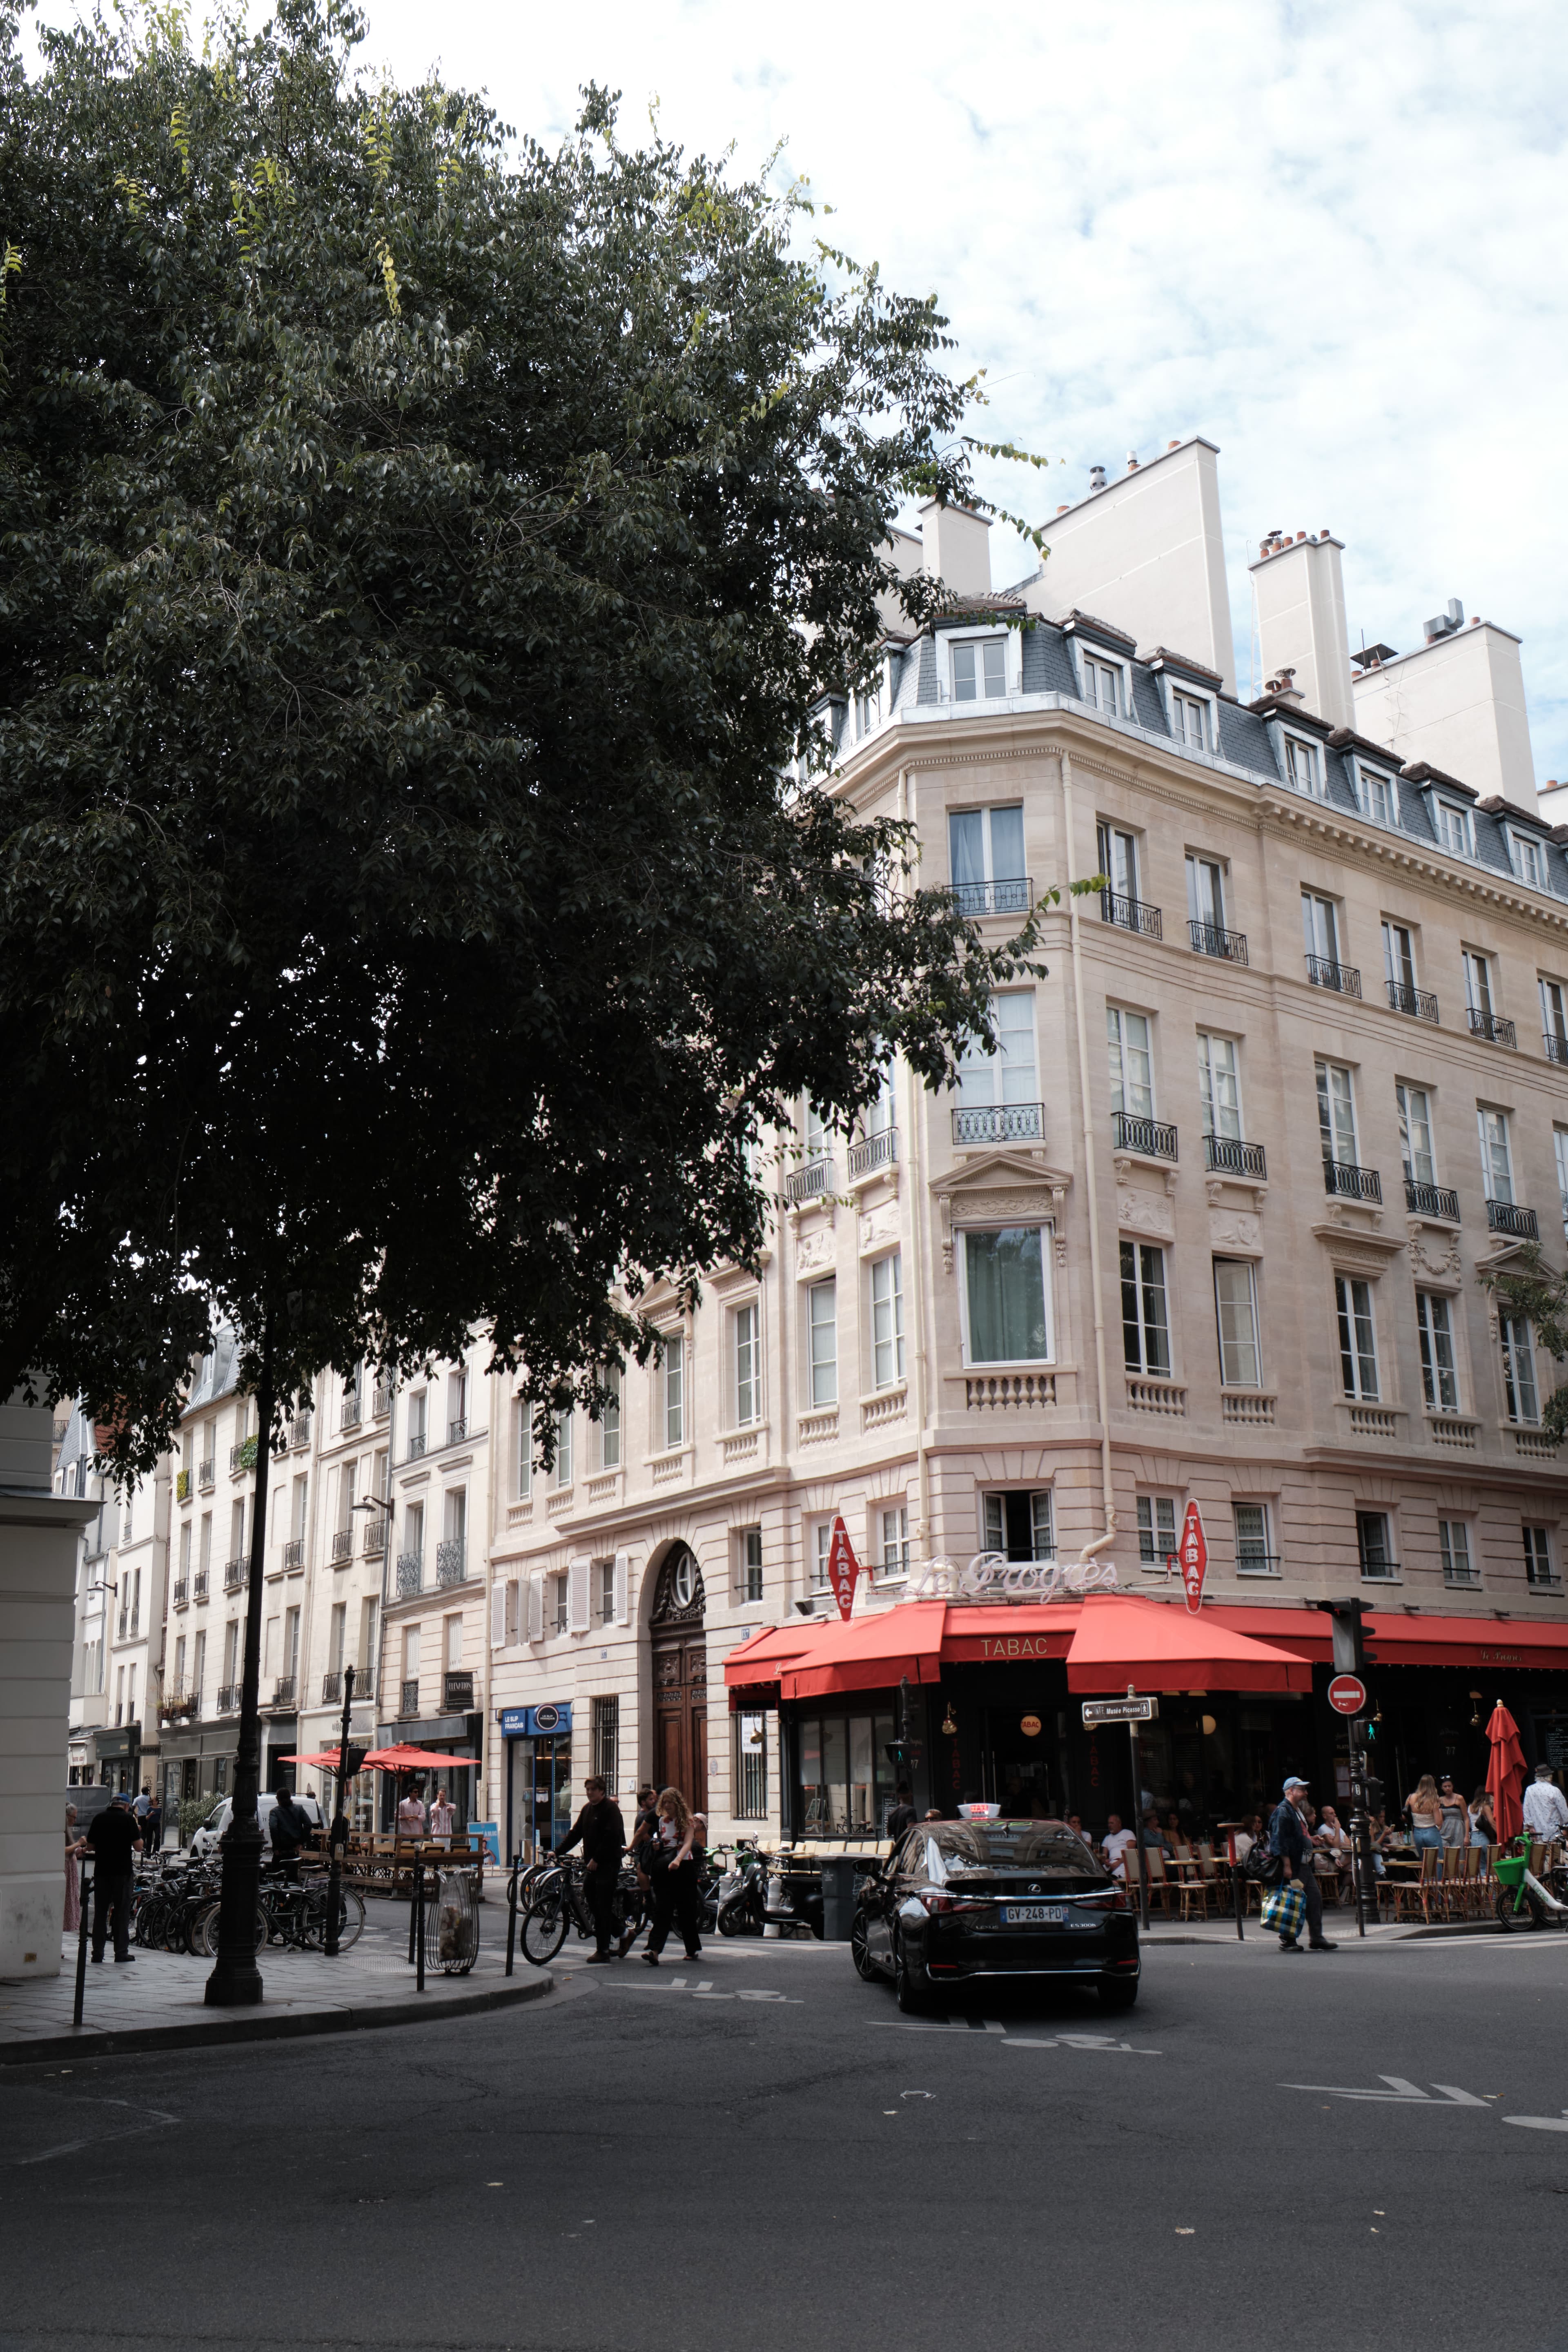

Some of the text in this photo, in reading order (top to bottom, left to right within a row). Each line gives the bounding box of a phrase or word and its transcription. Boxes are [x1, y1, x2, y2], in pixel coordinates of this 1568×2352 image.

[835, 1530, 852, 1609] TABAC
[899, 1551, 1119, 1604] Le Progrès
[1186, 1516, 1199, 1595] TABAC
[981, 1638, 1048, 1656] TABAC
[449, 1682, 471, 1690] ELEVATION
[951, 1737, 960, 1789] TABAC
[1089, 1735, 1099, 1787] TABAC
[1009, 1907, 1061, 1920] GV-248-PD
